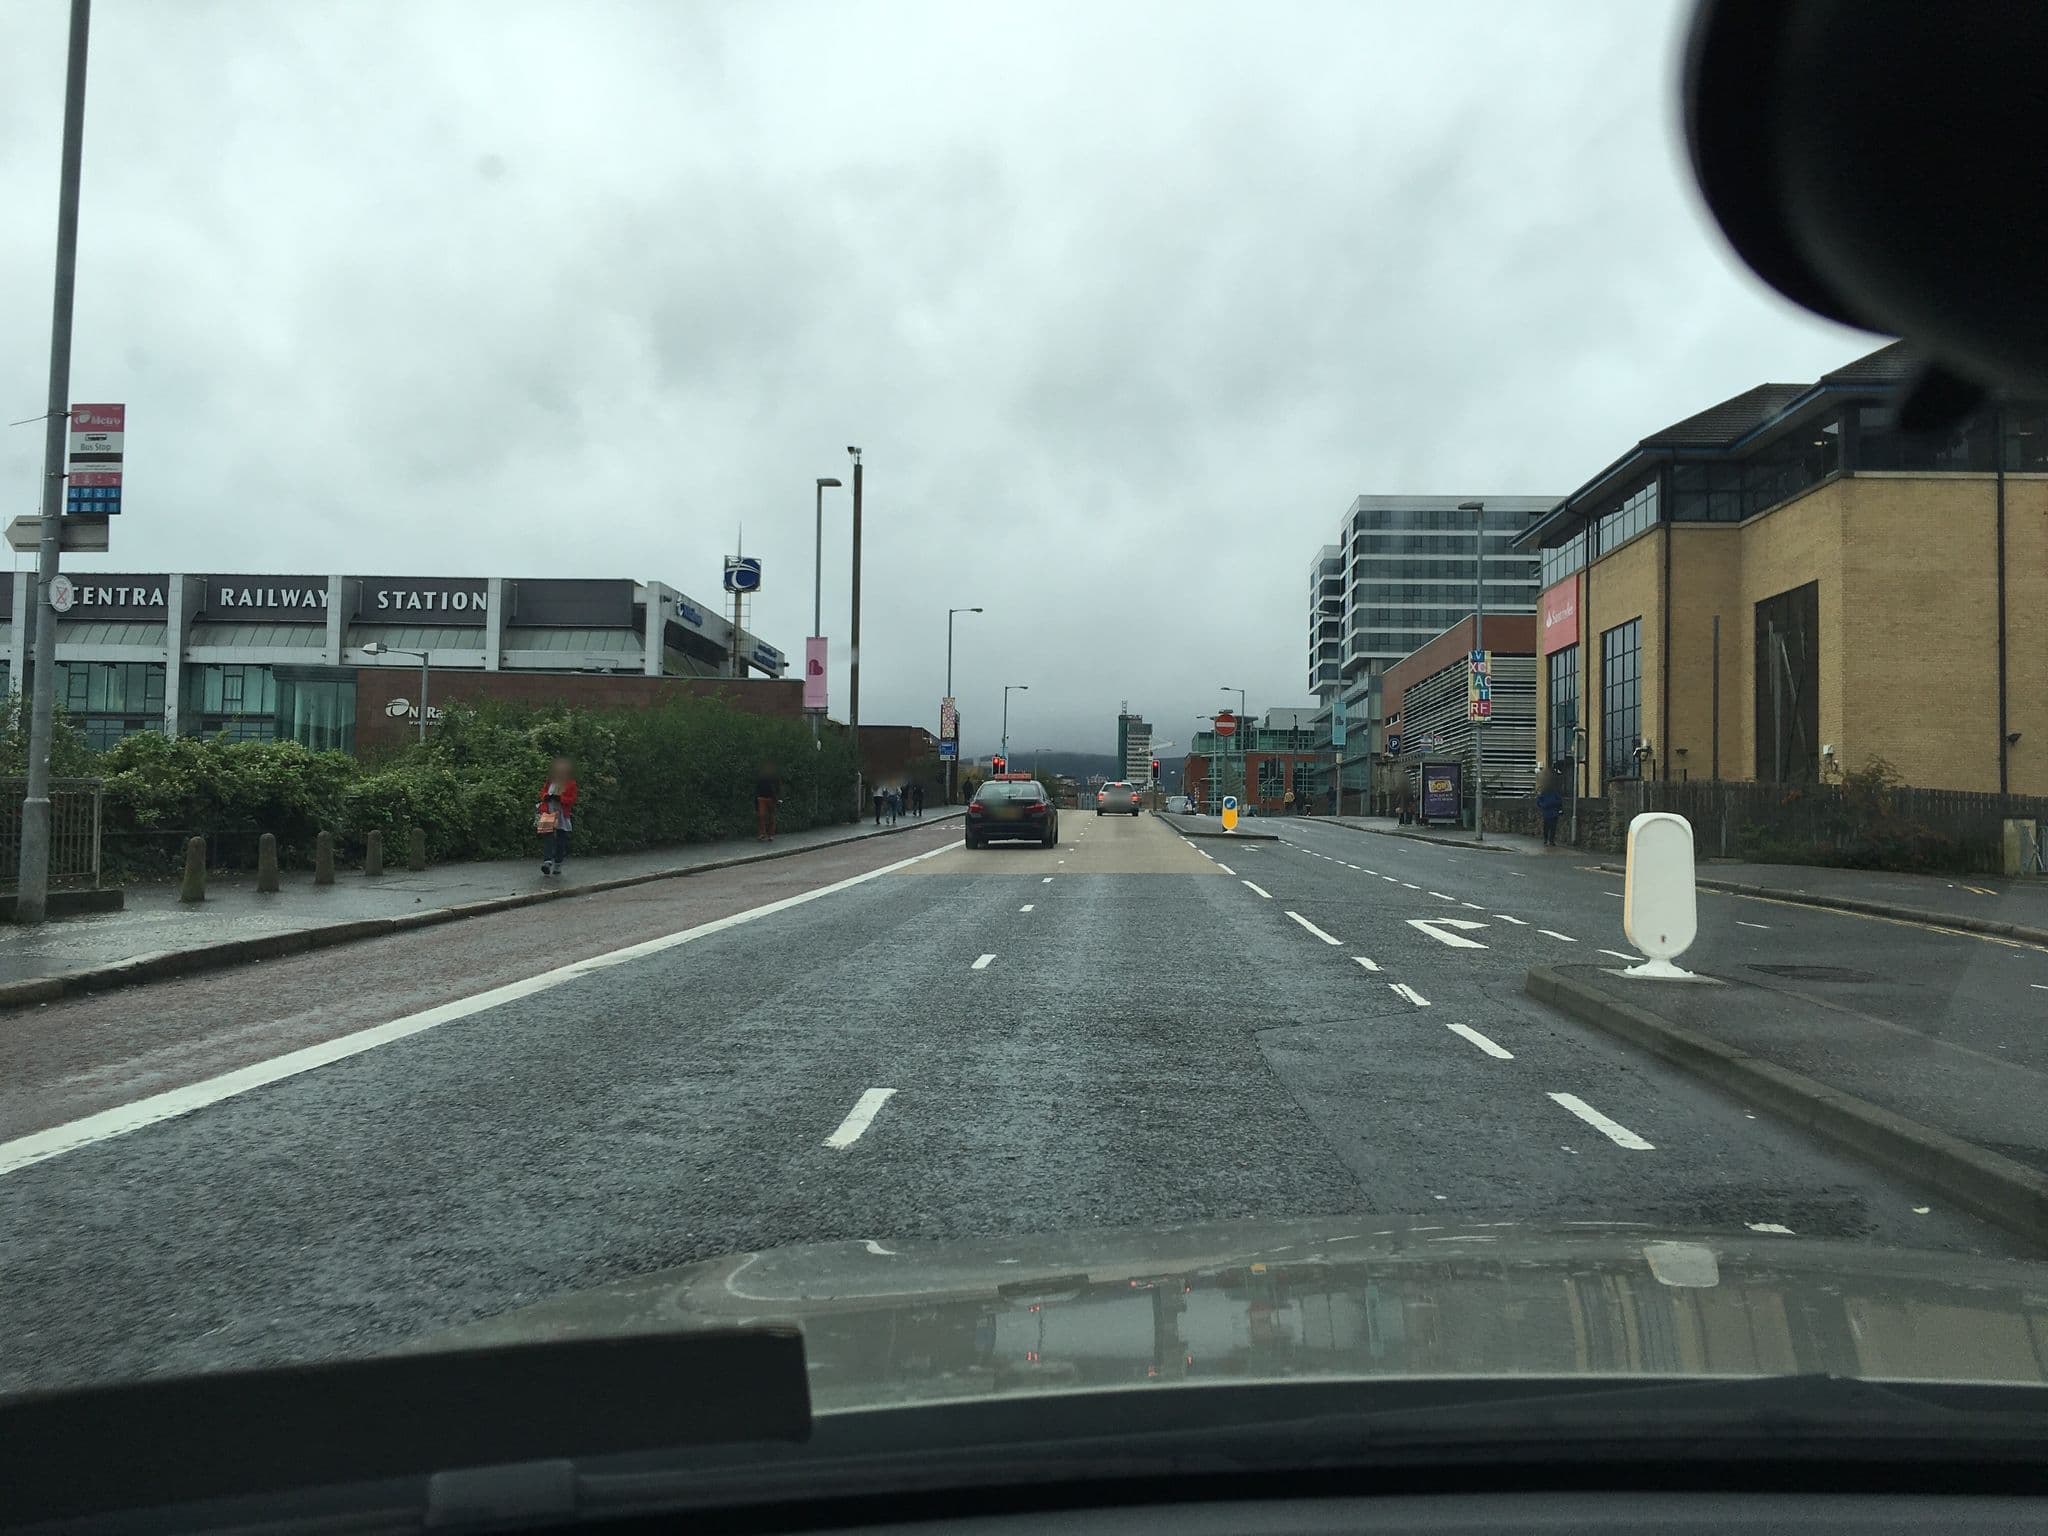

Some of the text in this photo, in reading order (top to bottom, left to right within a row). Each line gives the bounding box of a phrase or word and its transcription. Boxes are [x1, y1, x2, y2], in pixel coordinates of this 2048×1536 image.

[80, 442, 112, 452] Bus Stop
[72, 587, 487, 610] ENTRA RAILWAY STATION
